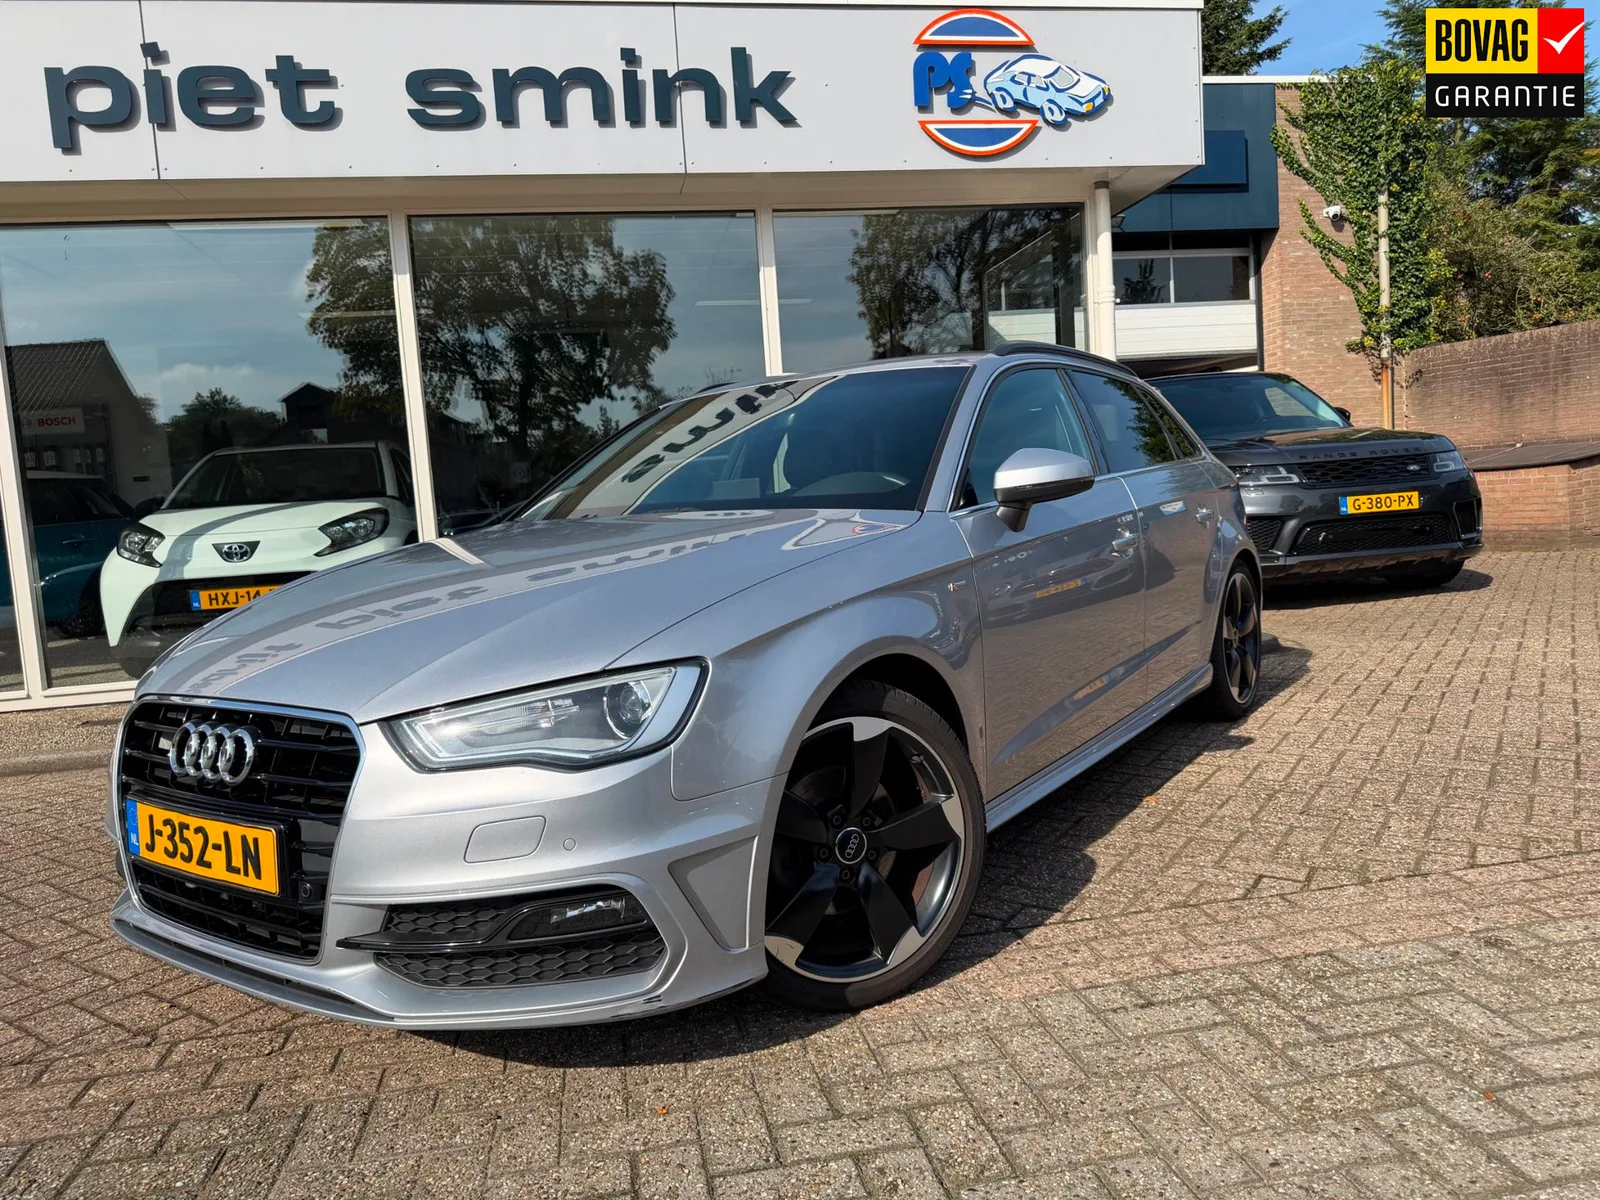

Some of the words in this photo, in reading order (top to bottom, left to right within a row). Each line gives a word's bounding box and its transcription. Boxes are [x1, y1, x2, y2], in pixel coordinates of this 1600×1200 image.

[44, 41, 336, 149] piet
[405, 47, 798, 125] smink
[37, 416, 77, 427] BOSCH
[1352, 494, 1414, 511] G-380-PX
[130, 832, 139, 846] NL
[145, 814, 262, 880] J-352-LN
